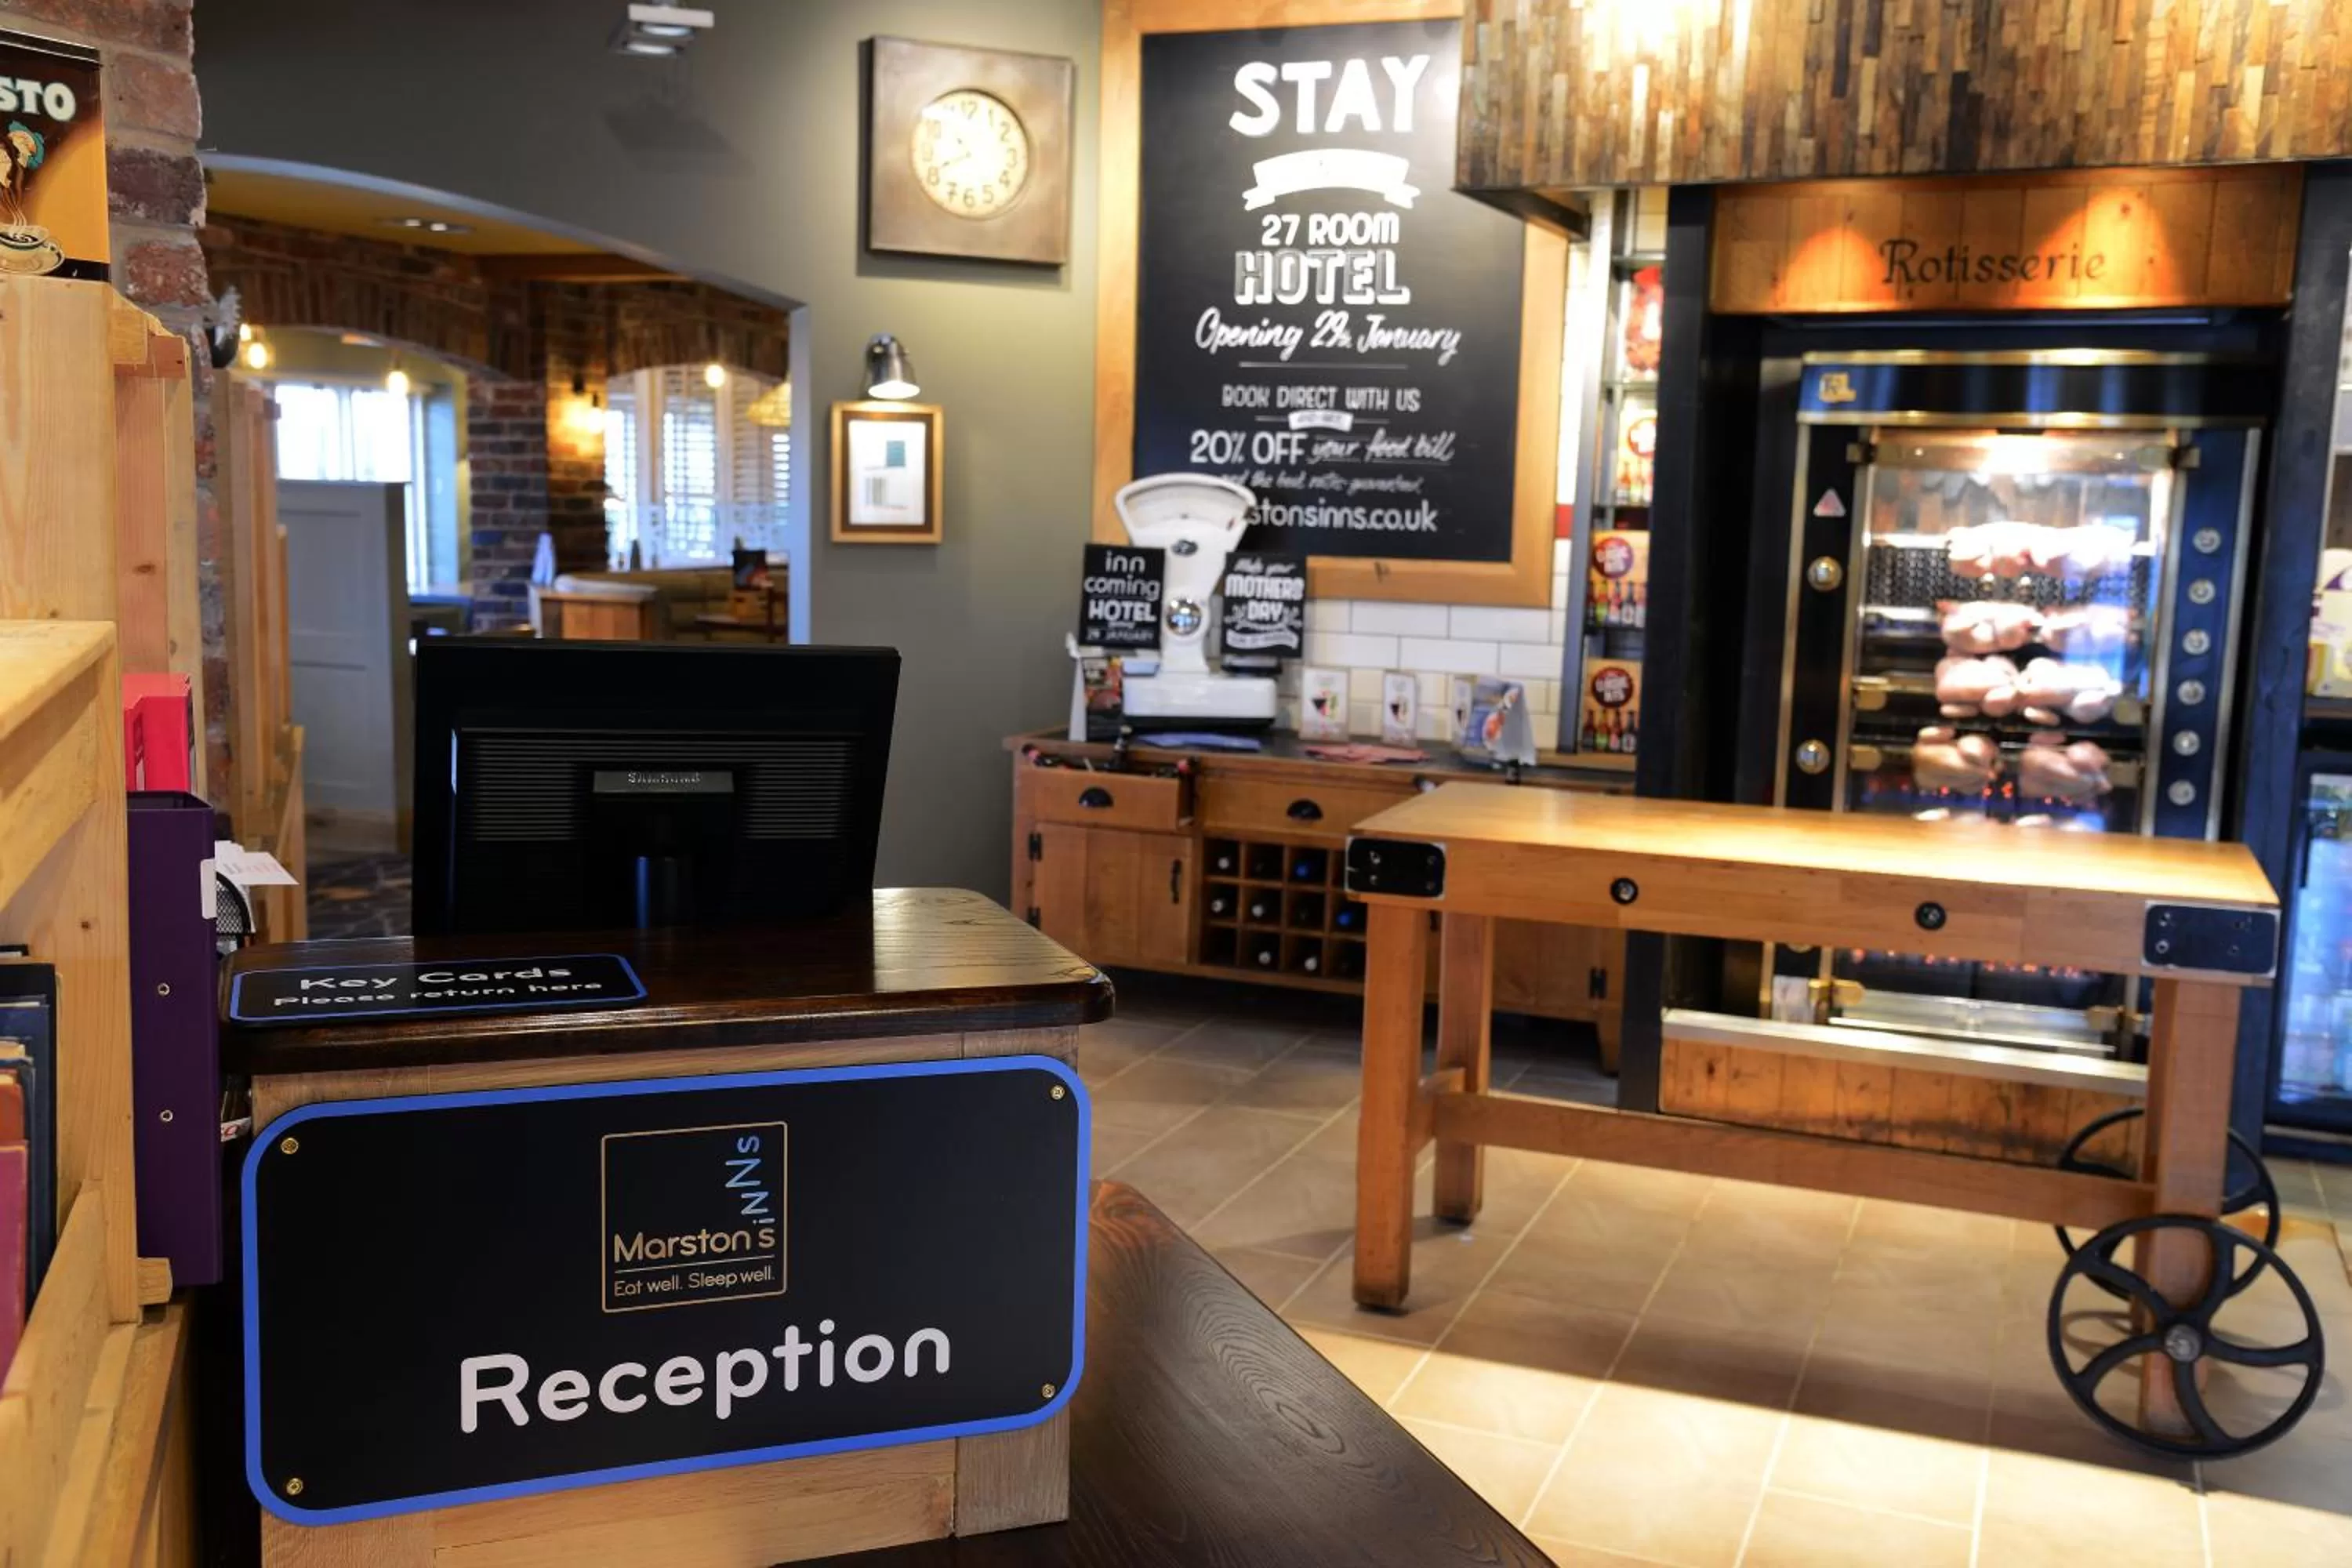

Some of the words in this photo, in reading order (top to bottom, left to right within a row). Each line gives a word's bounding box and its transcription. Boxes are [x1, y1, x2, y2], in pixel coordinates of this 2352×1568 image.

[1229, 54, 1431, 137] STAY
[1261, 215, 1300, 245] 27
[1308, 212, 1399, 245] ROOM
[1235, 249, 1410, 305] HOTEL
[1878, 238, 2105, 285] Rotisserie
[1196, 307, 1303, 361] Opening
[1357, 314, 1462, 366] January
[1221, 384, 1270, 408] BOOK
[1276, 386, 1338, 408] DIRECT
[1345, 387, 1389, 411] WITH
[1396, 388, 1421, 412] US
[1190, 430, 1247, 464] 20%
[1252, 431, 1308, 465] OFF
[1365, 426, 1413, 463] food
[1414, 431, 1456, 462] bill
[1245, 496, 1439, 532] stonsinns.co.uk
[1105, 550, 1145, 573] inn
[1084, 574, 1160, 602] coming
[1087, 599, 1157, 622] HOTEL
[1247, 600, 1283, 622] DAY
[300, 977, 398, 990] Key
[418, 967, 572, 983] Cards
[274, 993, 395, 1007] Please
[410, 988, 515, 999] return
[528, 983, 602, 992] here
[614, 1280, 641, 1297] Eat
[646, 1275, 683, 1292] well.
[688, 1272, 738, 1289] Sleep
[740, 1265, 775, 1283] well.
[460, 1319, 951, 1434] Reception
